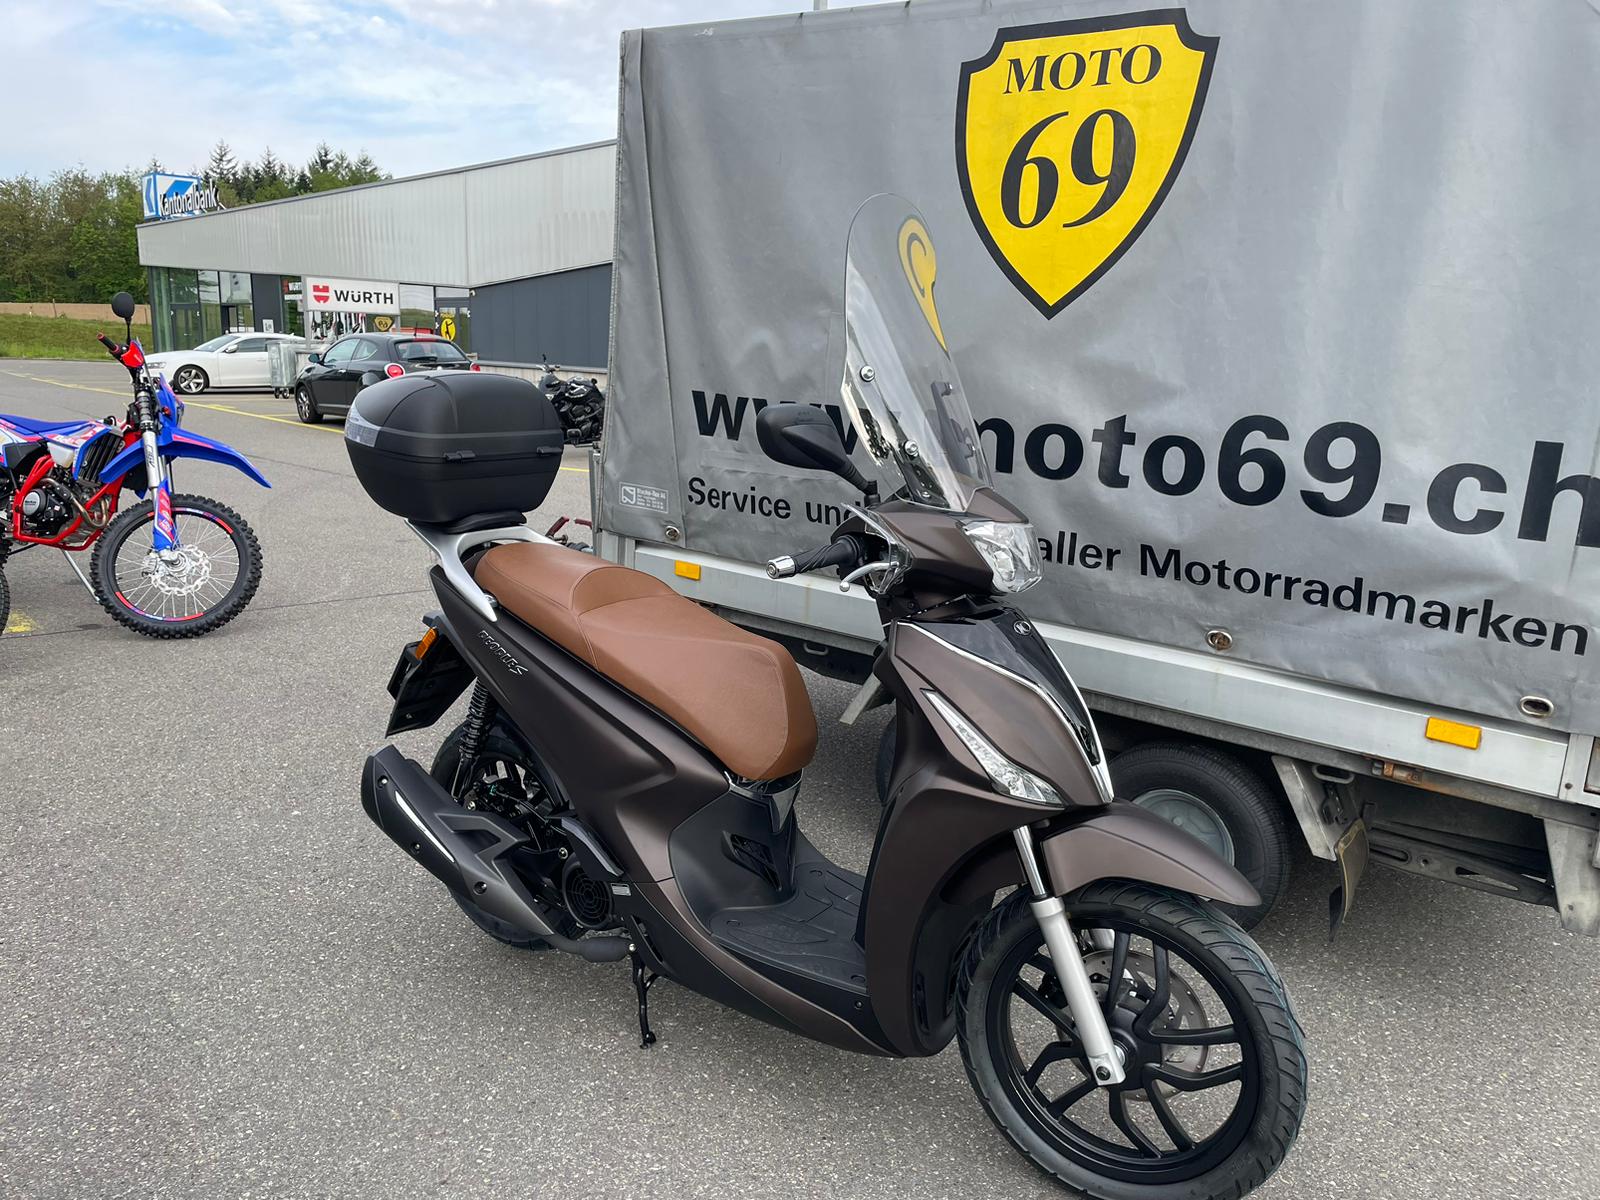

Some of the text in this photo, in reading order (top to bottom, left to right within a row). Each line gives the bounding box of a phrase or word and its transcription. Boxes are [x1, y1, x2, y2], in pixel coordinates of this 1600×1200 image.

[1002, 44, 1162, 95] MOTO
[159, 179, 217, 217] Kantonalbank
[1001, 109, 1137, 229] 69
[691, 389, 1600, 548] wmoto69.ch
[688, 476, 792, 520] Service
[1037, 530, 1122, 571] aller
[1140, 543, 1589, 656] Motorradmarken
